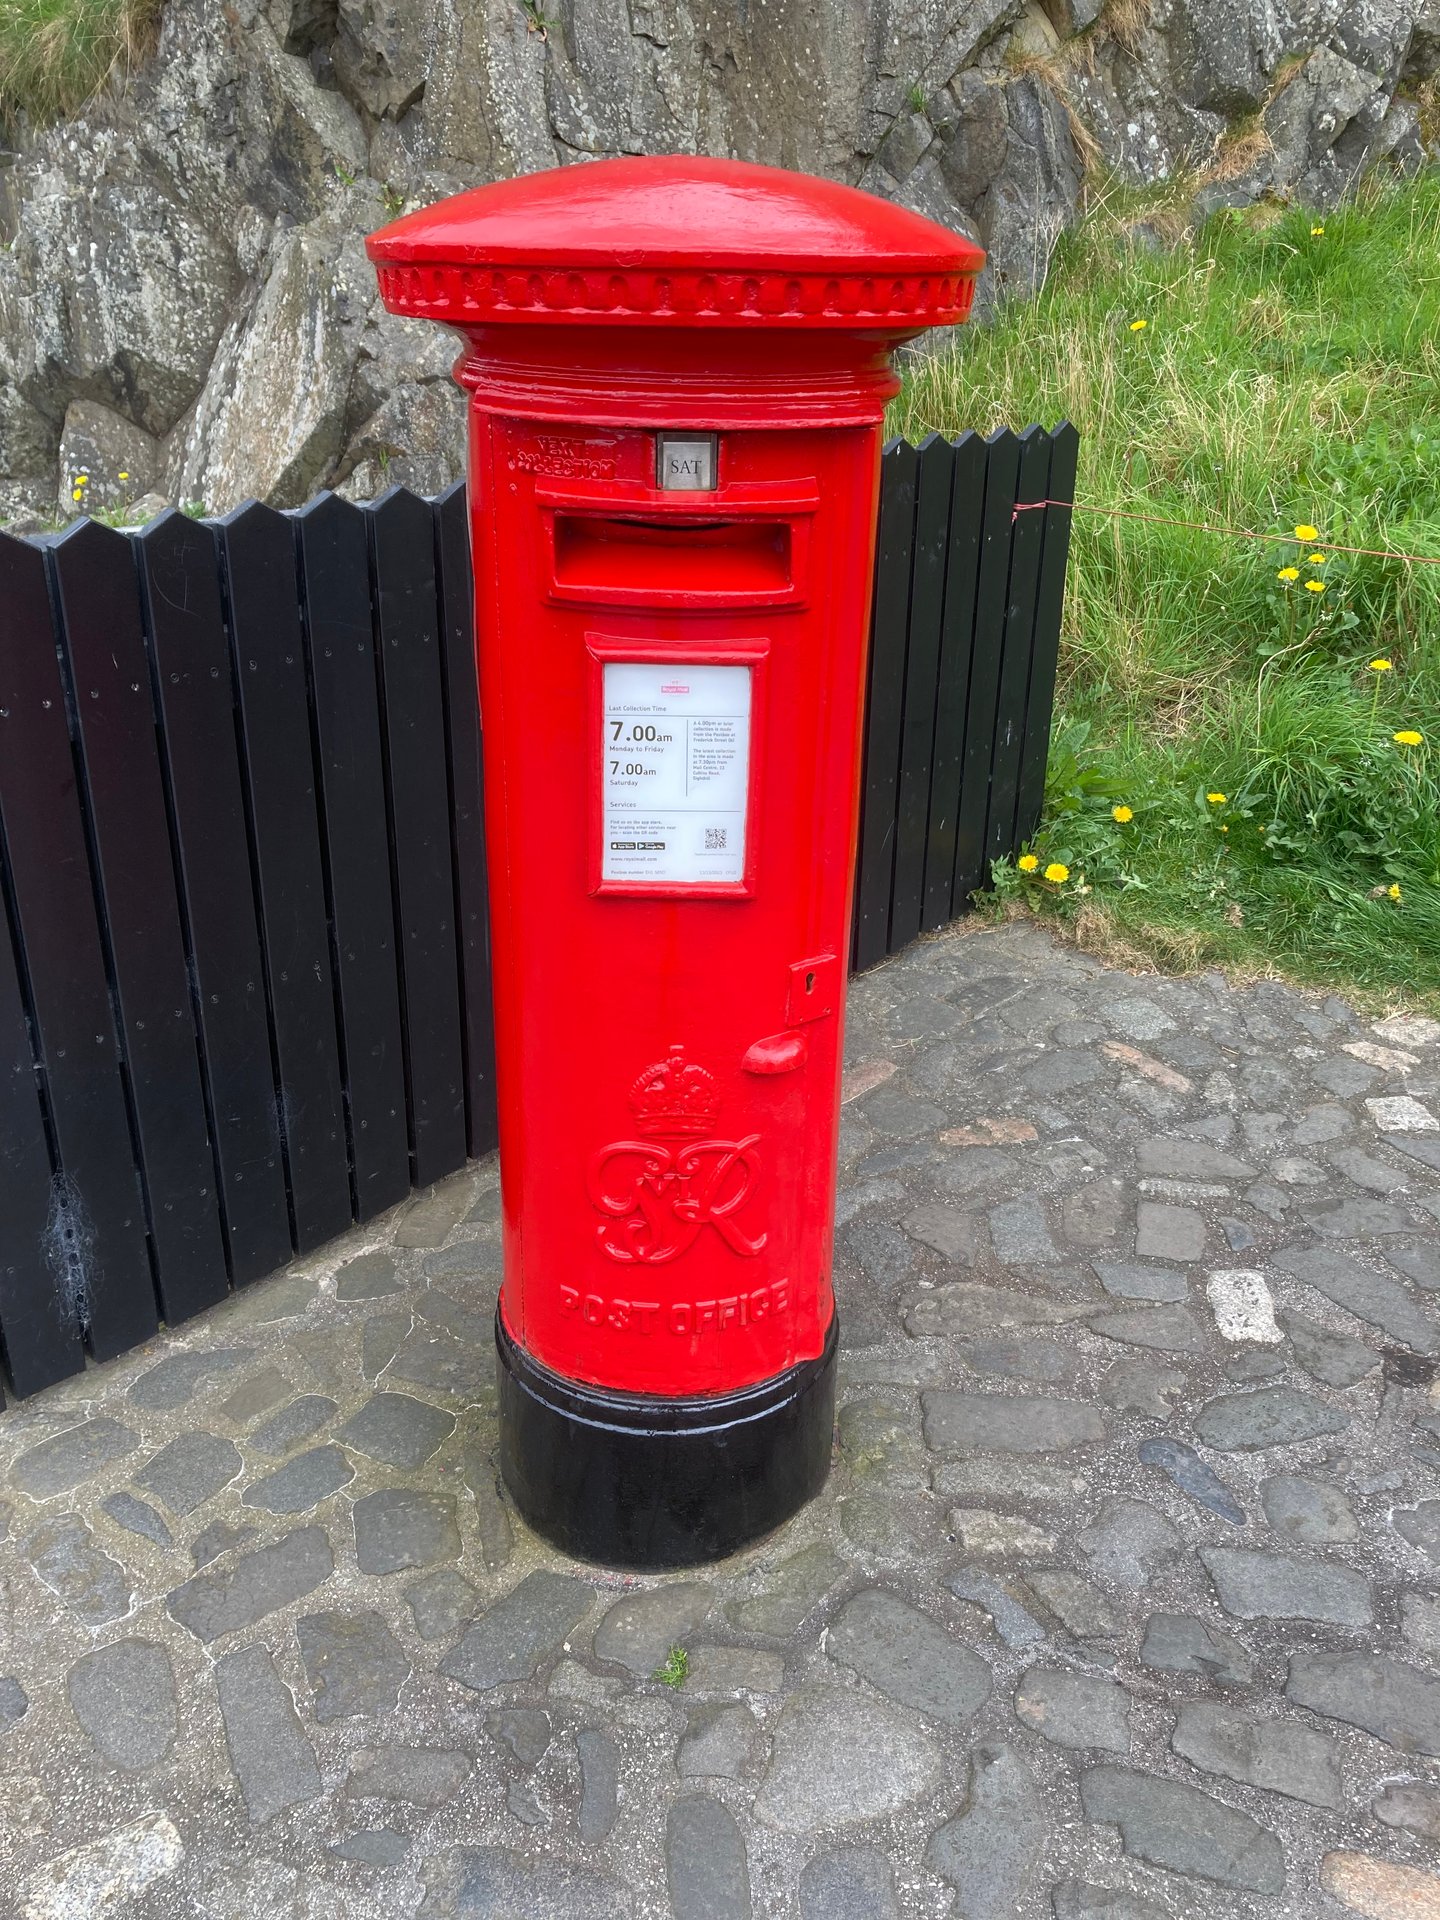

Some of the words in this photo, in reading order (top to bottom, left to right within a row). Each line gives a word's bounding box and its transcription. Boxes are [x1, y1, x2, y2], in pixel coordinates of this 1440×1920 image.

[670, 459, 702, 475] SAT
[610, 721, 672, 742] 7.00am
[610, 761, 656, 775] 7.00am
[560, 1284, 661, 1334] POST
[671, 1277, 789, 1335] OFFICE
